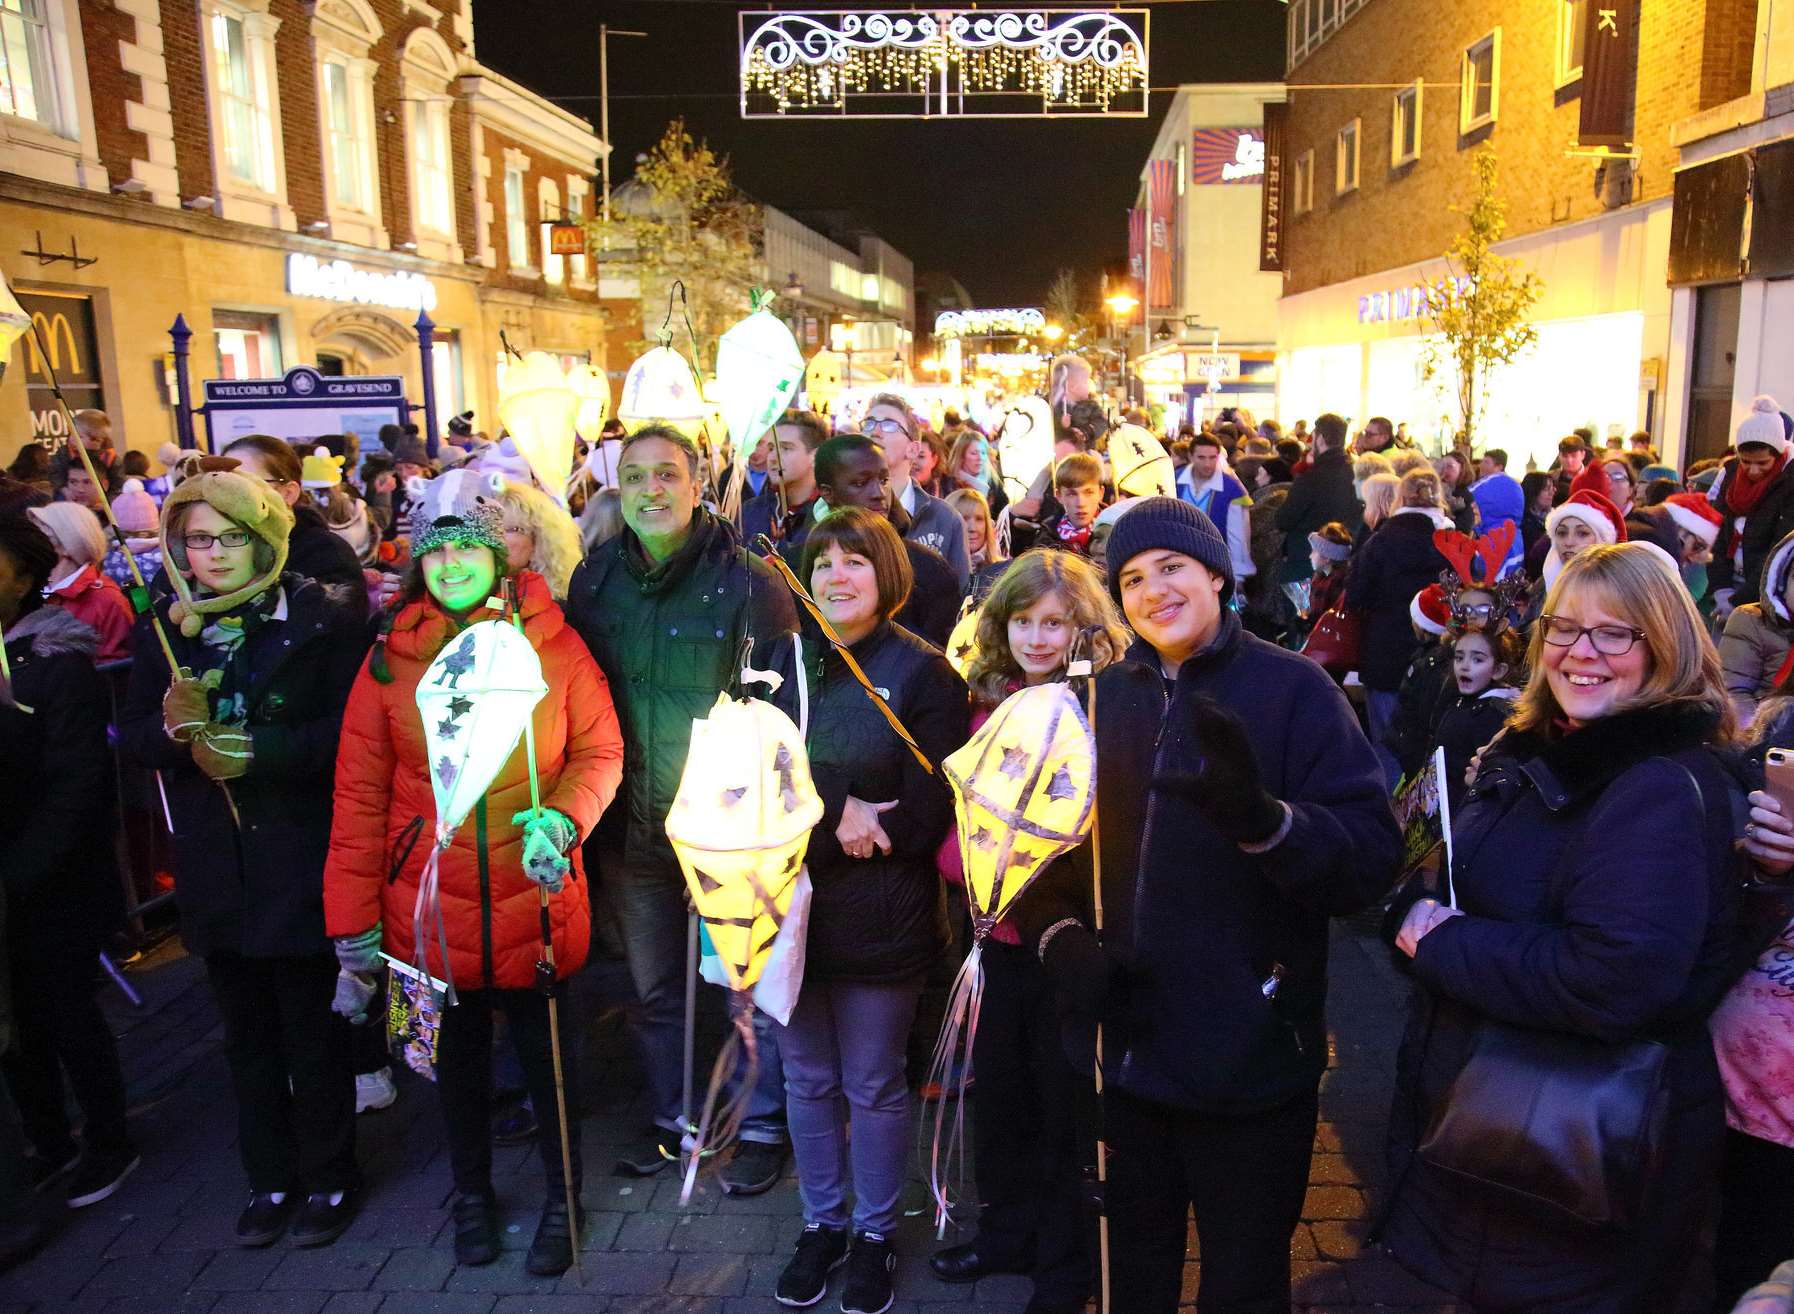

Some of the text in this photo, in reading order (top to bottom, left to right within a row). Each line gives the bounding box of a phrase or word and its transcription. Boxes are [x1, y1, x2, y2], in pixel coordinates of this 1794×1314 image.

[1265, 155, 1281, 260] PRIMARK
[214, 383, 393, 396] WELCOME TO GRAVESEND
